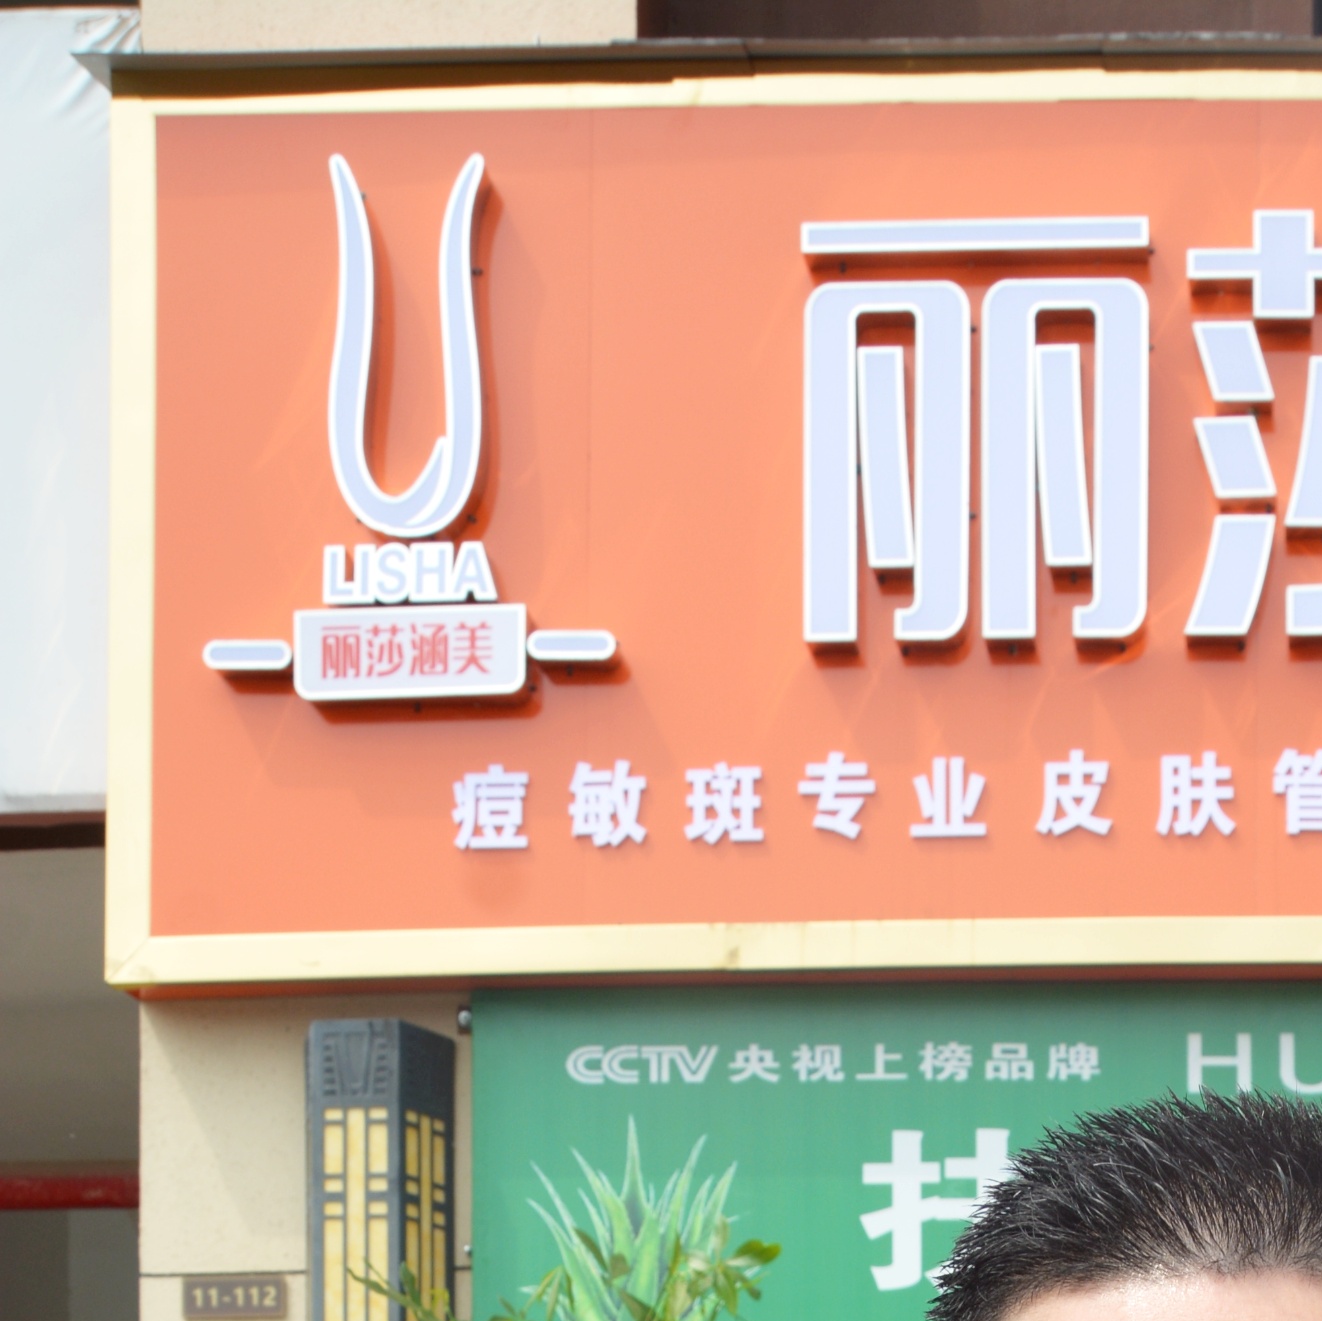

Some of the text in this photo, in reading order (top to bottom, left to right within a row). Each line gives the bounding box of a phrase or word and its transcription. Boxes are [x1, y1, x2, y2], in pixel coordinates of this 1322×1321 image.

[323, 541, 498, 606] LISHA
[320, 620, 495, 682] 丽莎涵美
[565, 1041, 1102, 1084] CCTV 央视上榜品牌
[192, 1285, 277, 1308] 11-112
